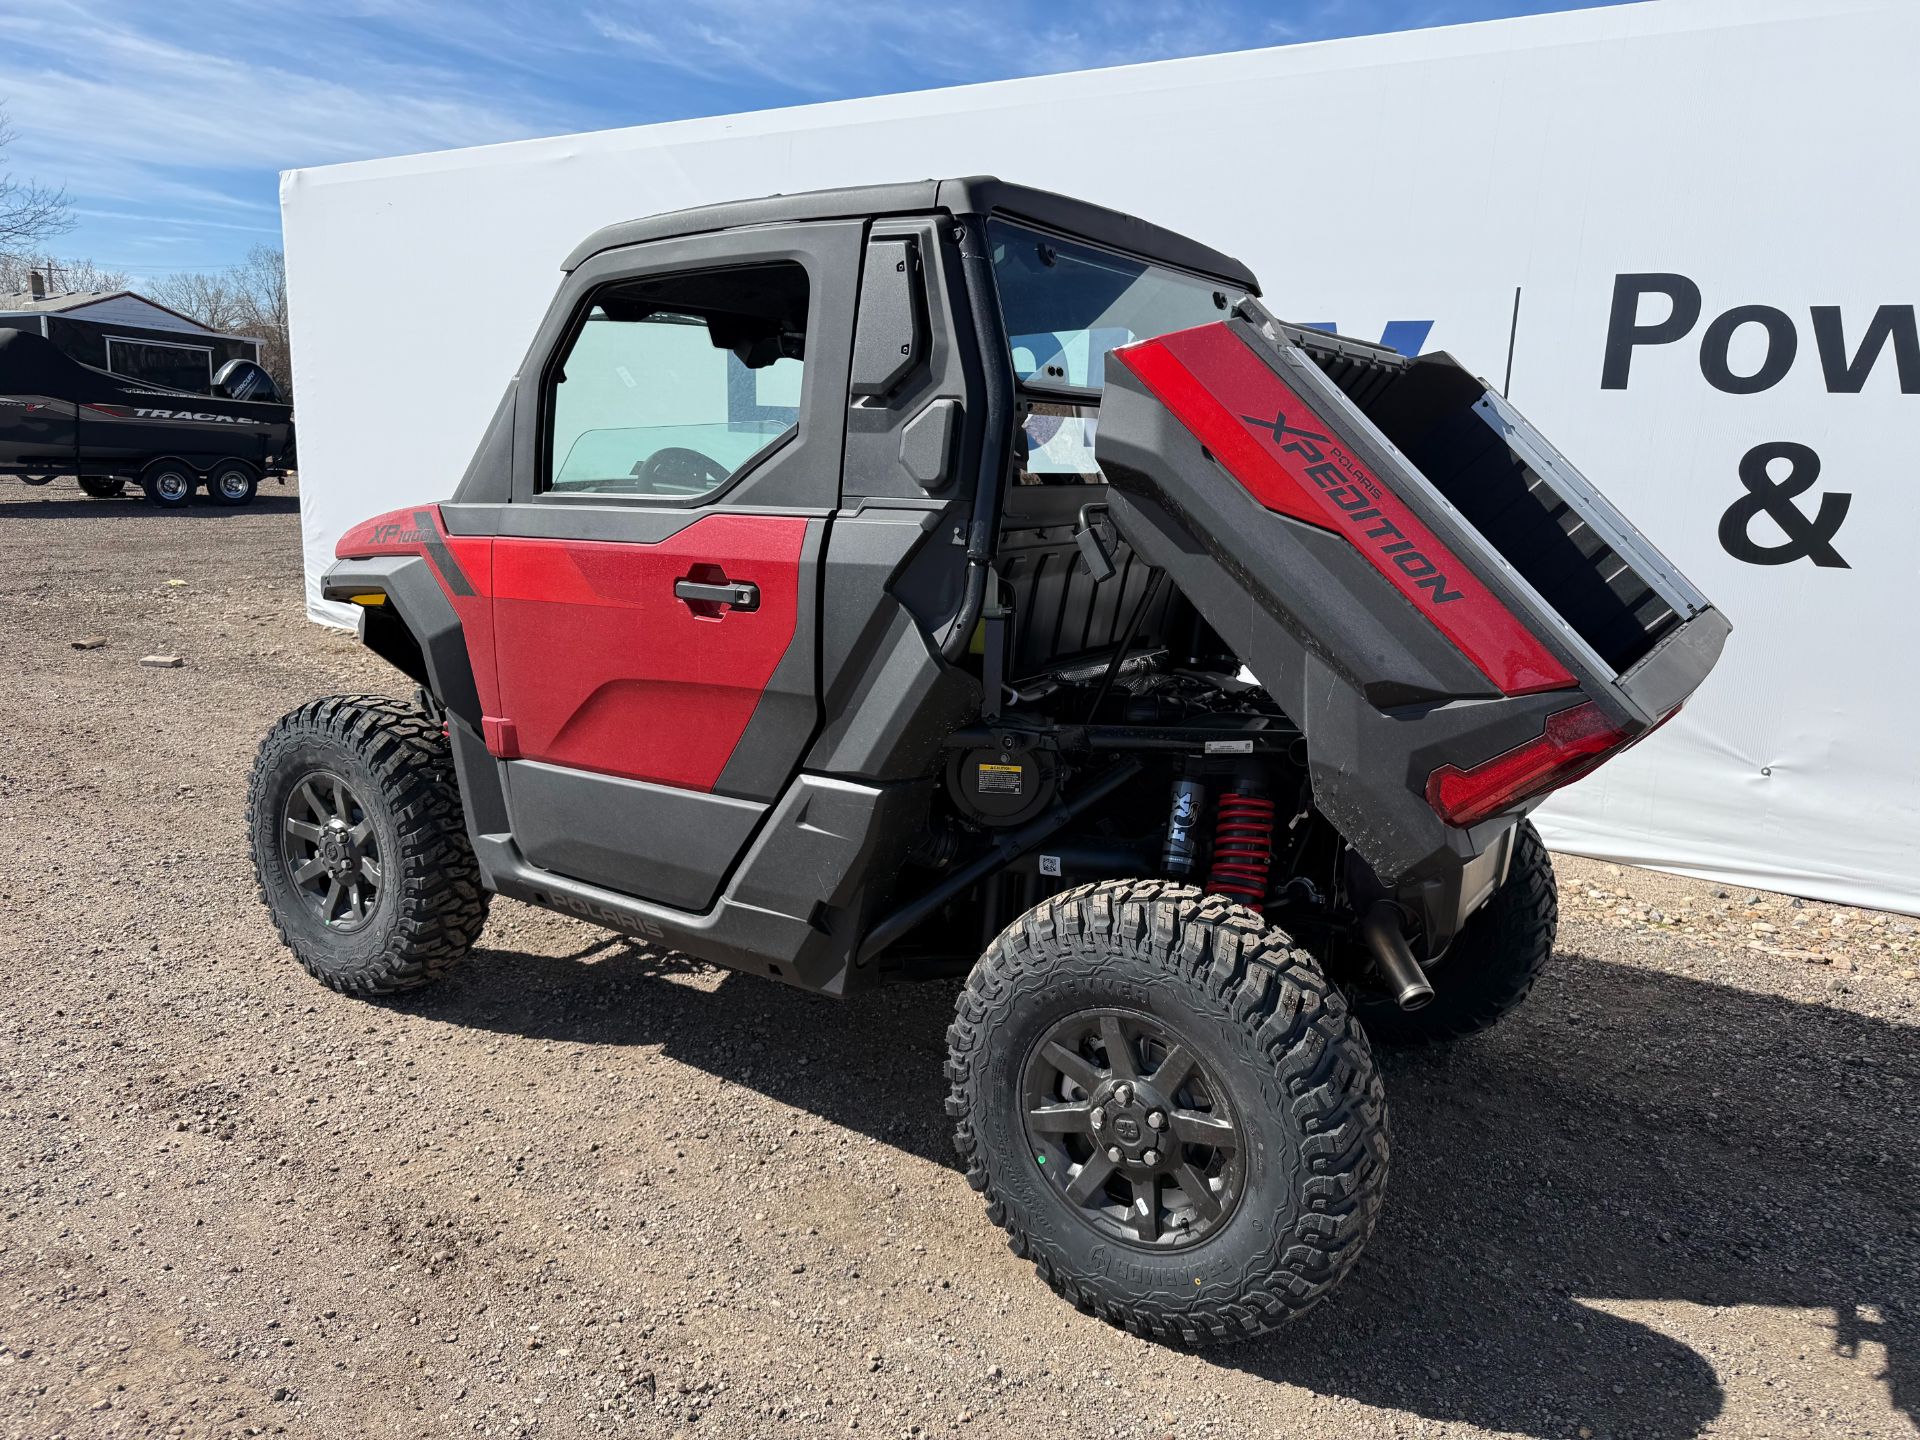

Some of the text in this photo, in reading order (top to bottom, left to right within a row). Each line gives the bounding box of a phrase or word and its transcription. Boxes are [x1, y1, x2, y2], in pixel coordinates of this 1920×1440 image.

[1600, 272, 1920, 395] Pow
[231, 369, 256, 399] MERCURY
[133, 408, 271, 425] TRACKE
[1330, 447, 1383, 500] POLARIS
[1239, 410, 1465, 604] XPEDITION
[1717, 441, 1852, 569] &
[1167, 792, 1200, 842] FOX
[548, 891, 664, 938] POLARIS
